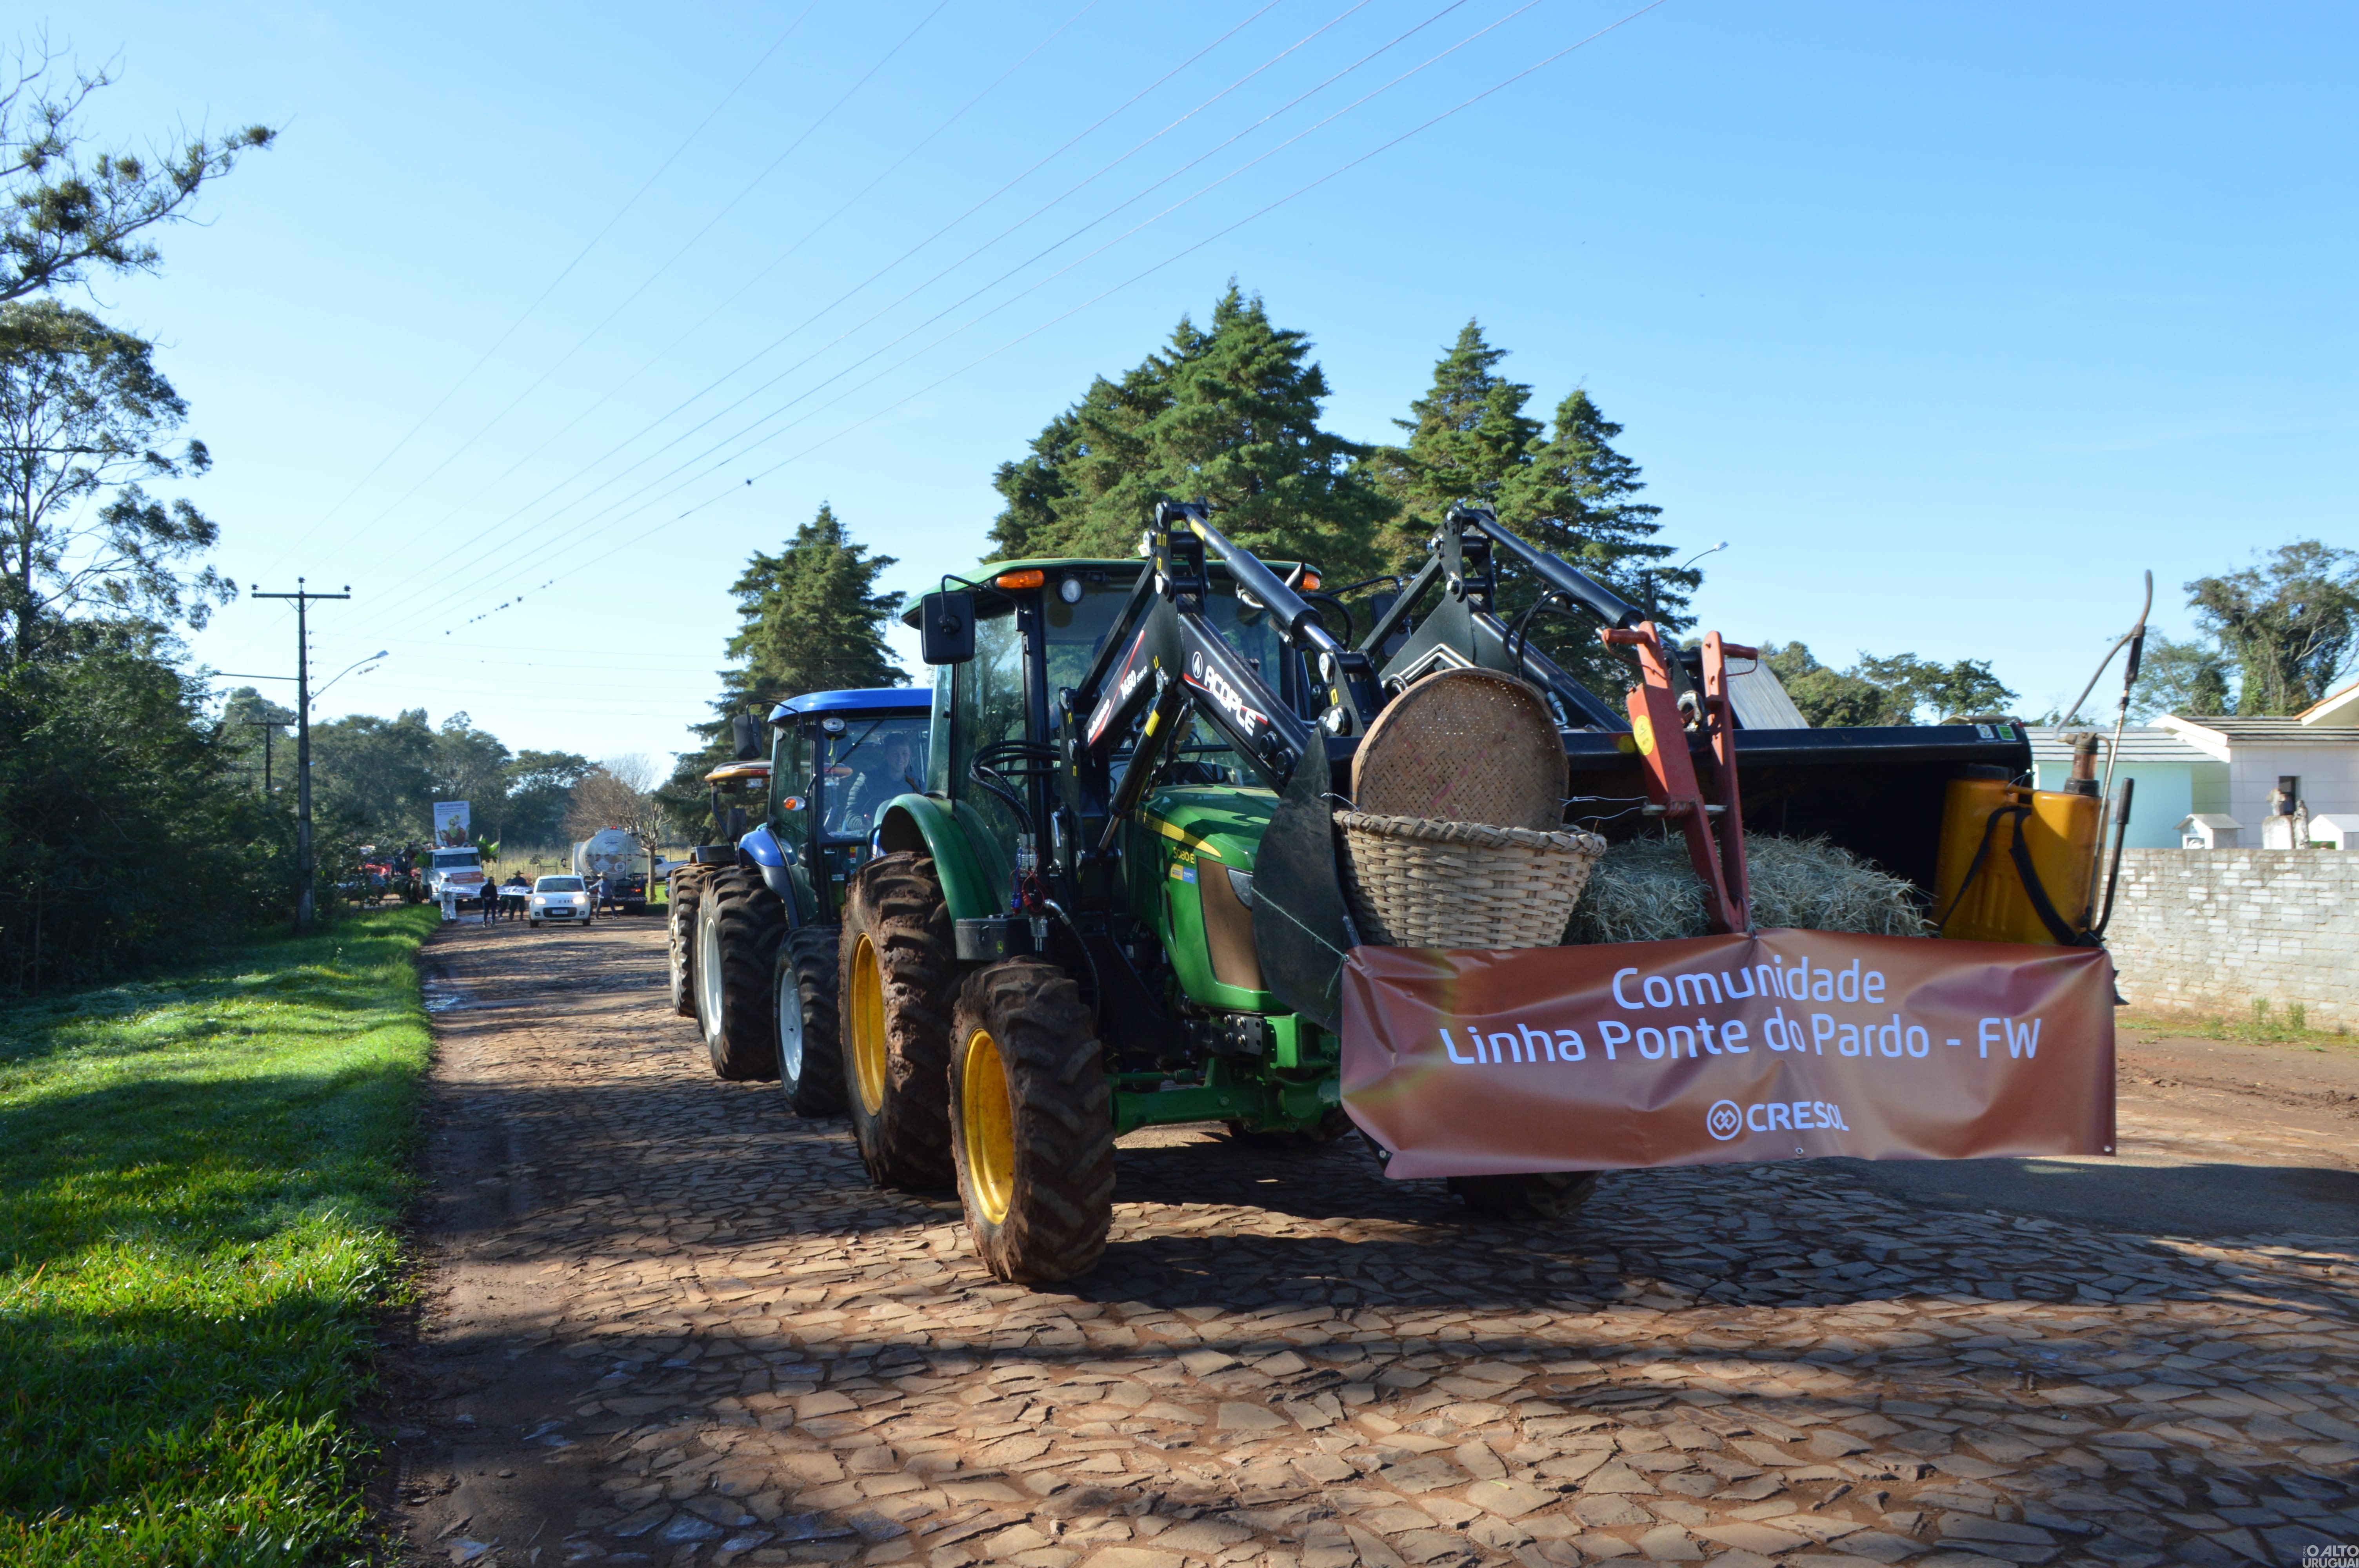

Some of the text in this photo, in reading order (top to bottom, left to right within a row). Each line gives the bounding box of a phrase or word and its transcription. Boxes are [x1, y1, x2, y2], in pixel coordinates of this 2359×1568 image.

[1120, 670, 1136, 700] 1450
[1204, 665, 1256, 737] ACOPLE
[1612, 955, 1885, 1009] Comunidade
[1439, 1023, 1586, 1065] Linha
[1597, 1017, 1750, 1060] Ponte
[1764, 1006, 1806, 1053] do
[1811, 1013, 1929, 1058] Pardo
[1978, 1018, 2041, 1058] FW
[1747, 1101, 1849, 1132] CRESOL
